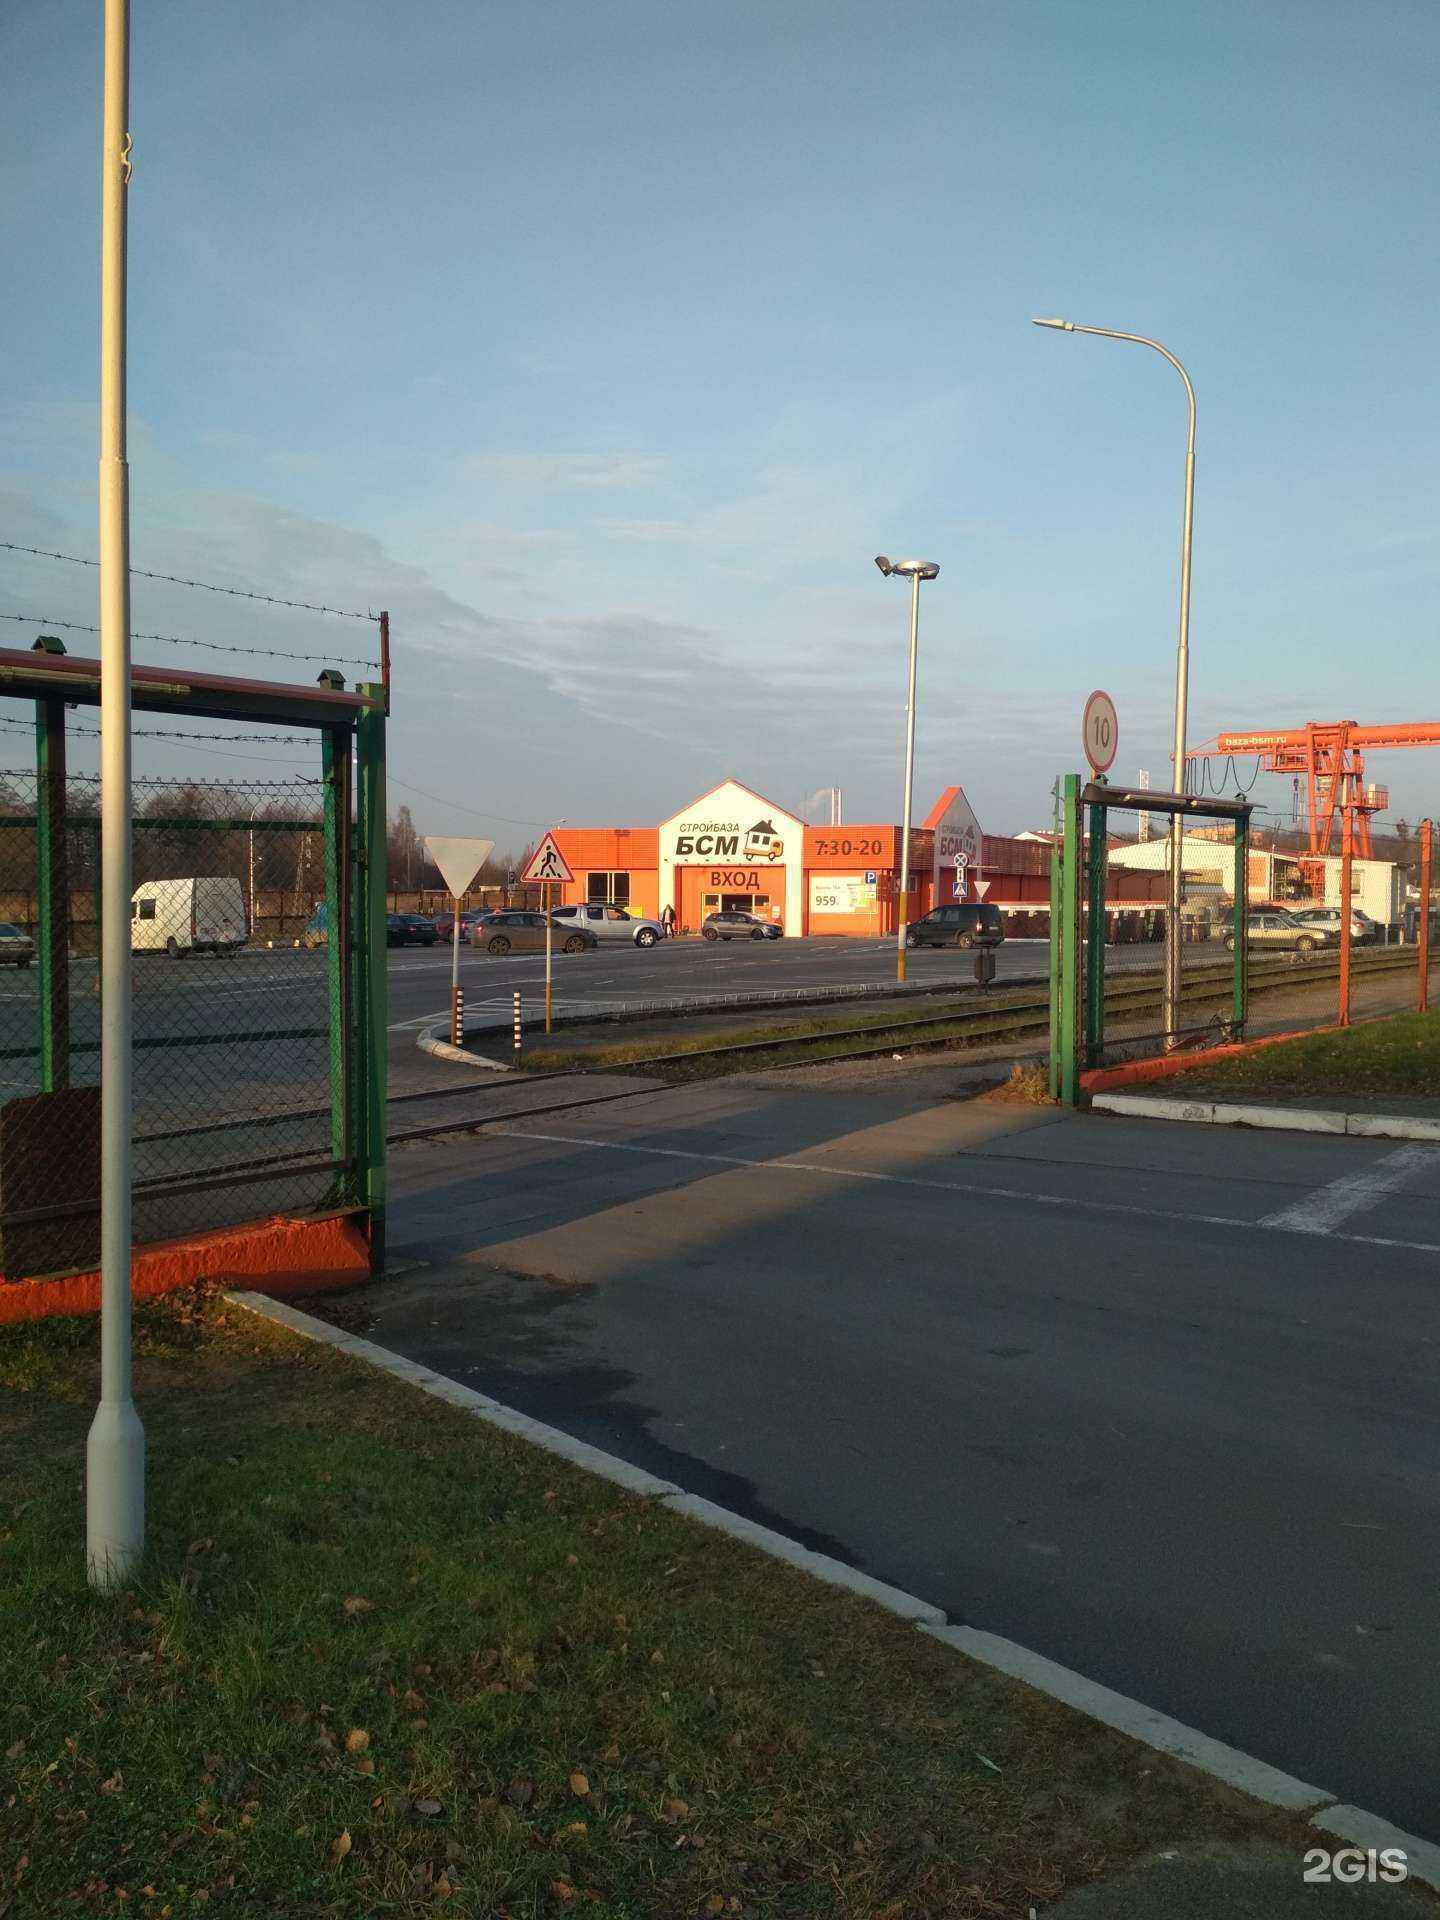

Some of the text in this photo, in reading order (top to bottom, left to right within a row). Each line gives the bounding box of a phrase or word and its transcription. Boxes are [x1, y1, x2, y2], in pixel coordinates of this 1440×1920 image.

[1094, 715, 1109, 748] 10
[679, 822, 740, 833] СТРОЙБАЗА
[675, 835, 740, 856] БСМ
[710, 871, 760, 890] ВХОД
